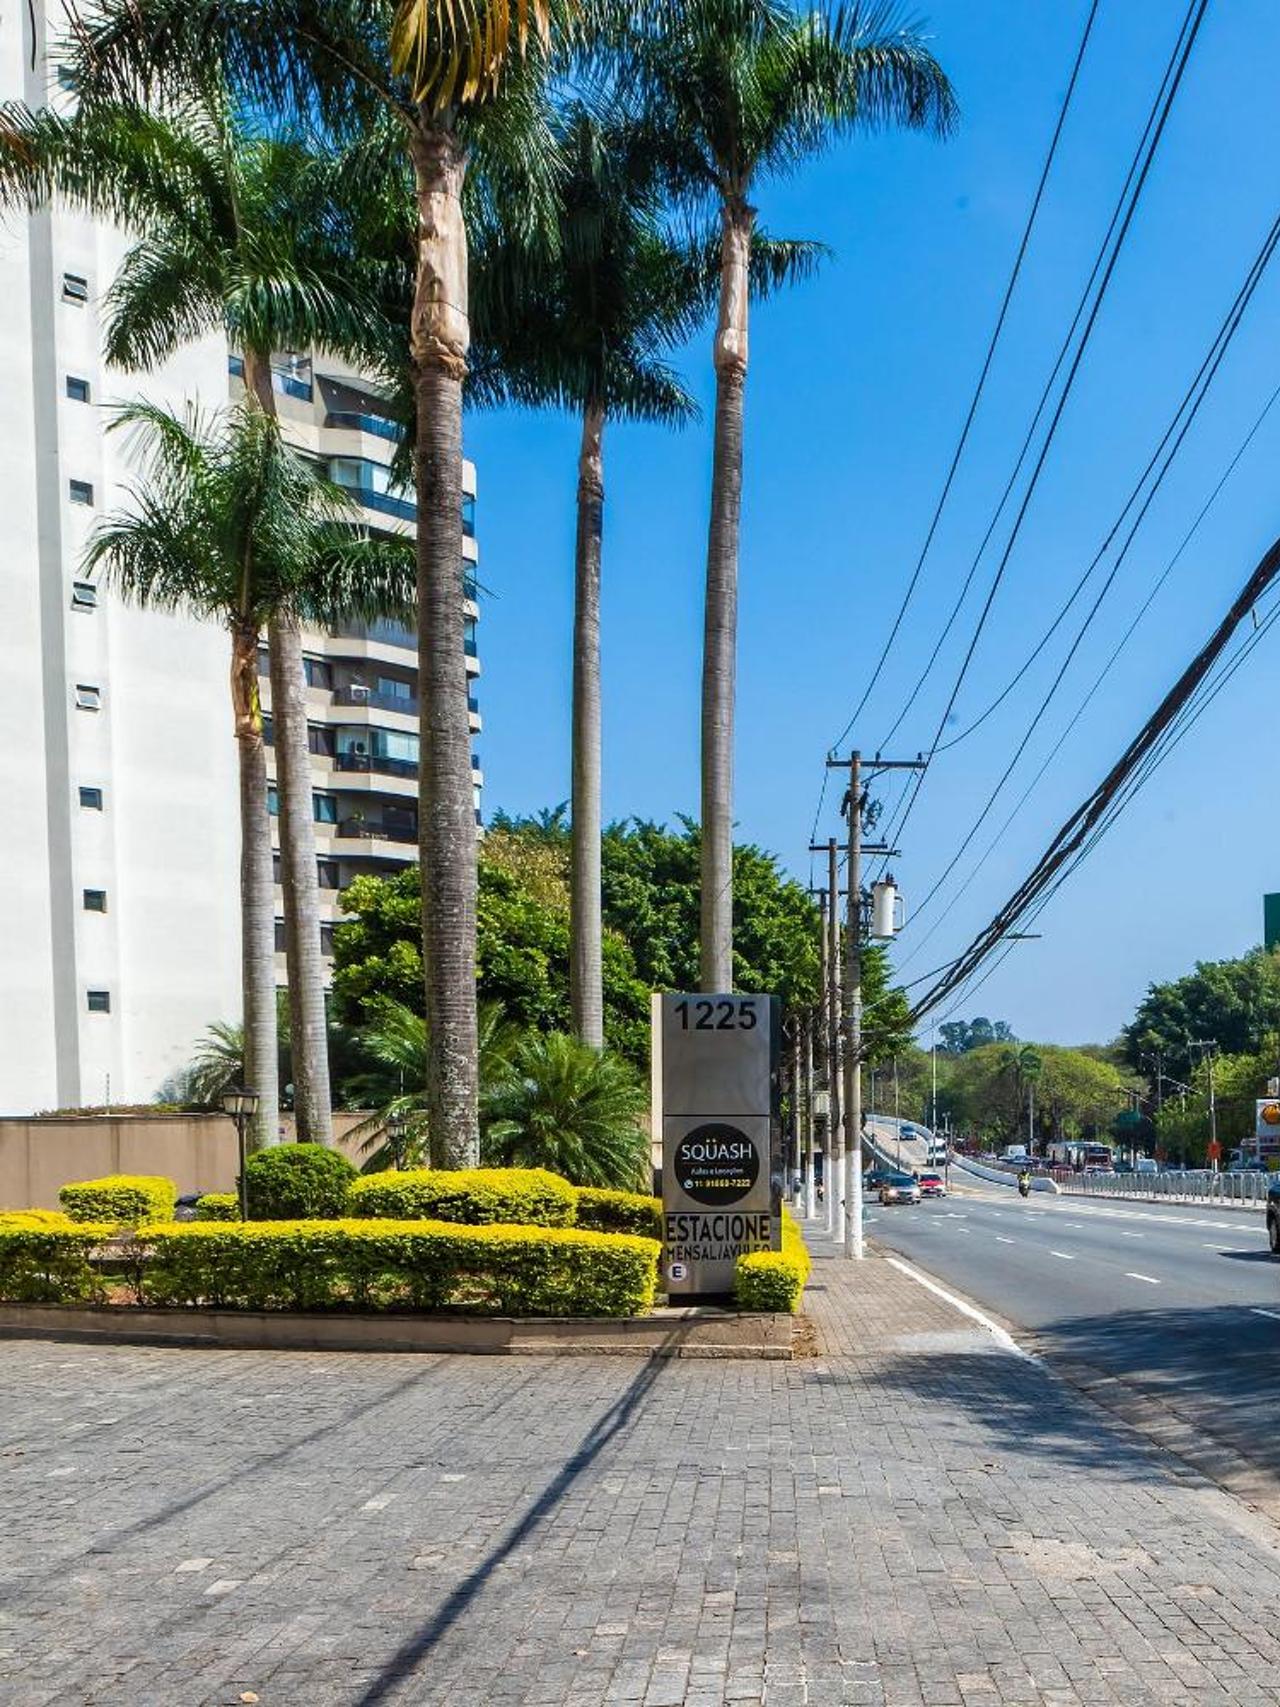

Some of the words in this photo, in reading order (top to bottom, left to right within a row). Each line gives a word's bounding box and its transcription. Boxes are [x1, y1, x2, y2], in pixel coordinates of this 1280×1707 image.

[674, 1001, 757, 1030] 1225
[666, 1215, 770, 1242] ESTACIONE
[672, 1266, 682, 1278] E
